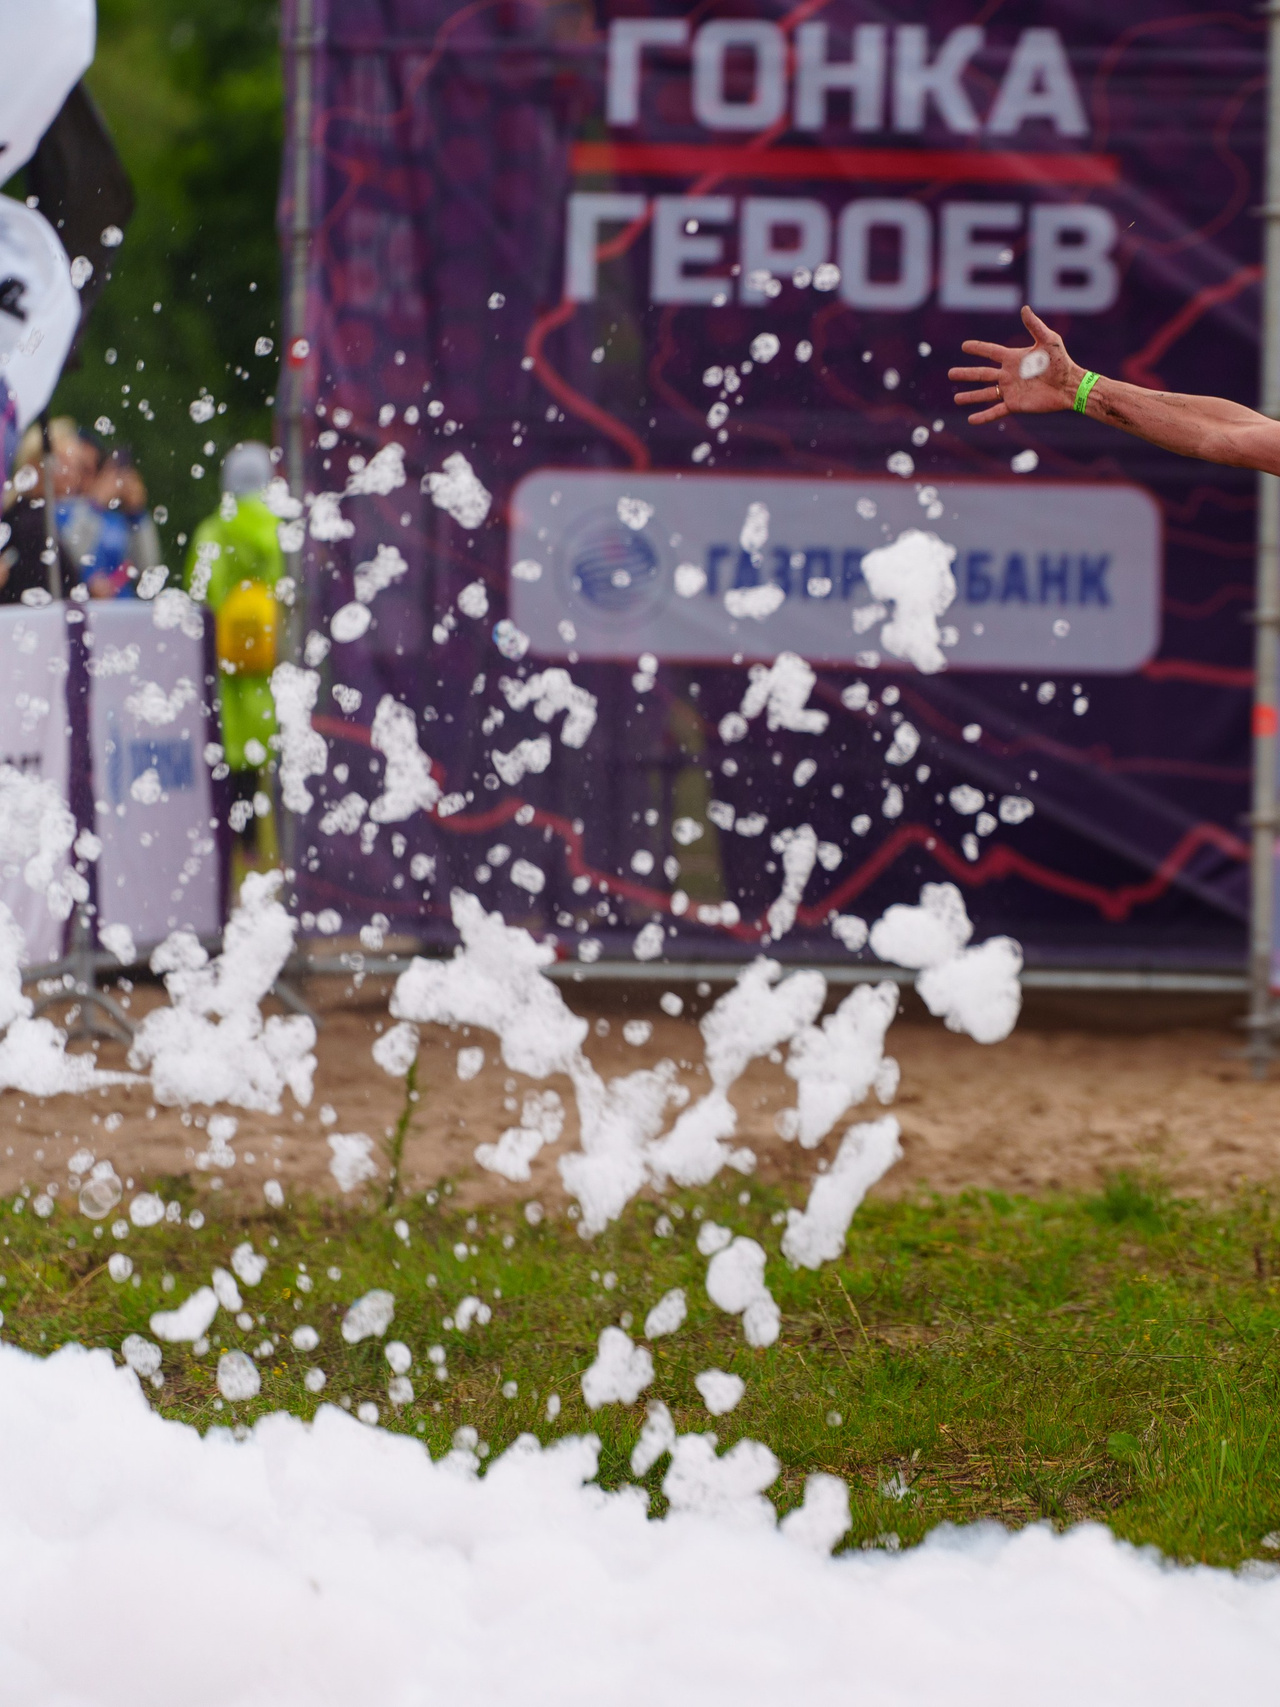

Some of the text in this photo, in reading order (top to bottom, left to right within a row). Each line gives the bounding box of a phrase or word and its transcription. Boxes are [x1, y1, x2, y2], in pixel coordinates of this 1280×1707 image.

[607, 17, 1091, 137] ГОНКА
[565, 193, 1121, 314] ГЕРОЕВ
[706, 544, 1113, 609] ГАЗПРБАНК
